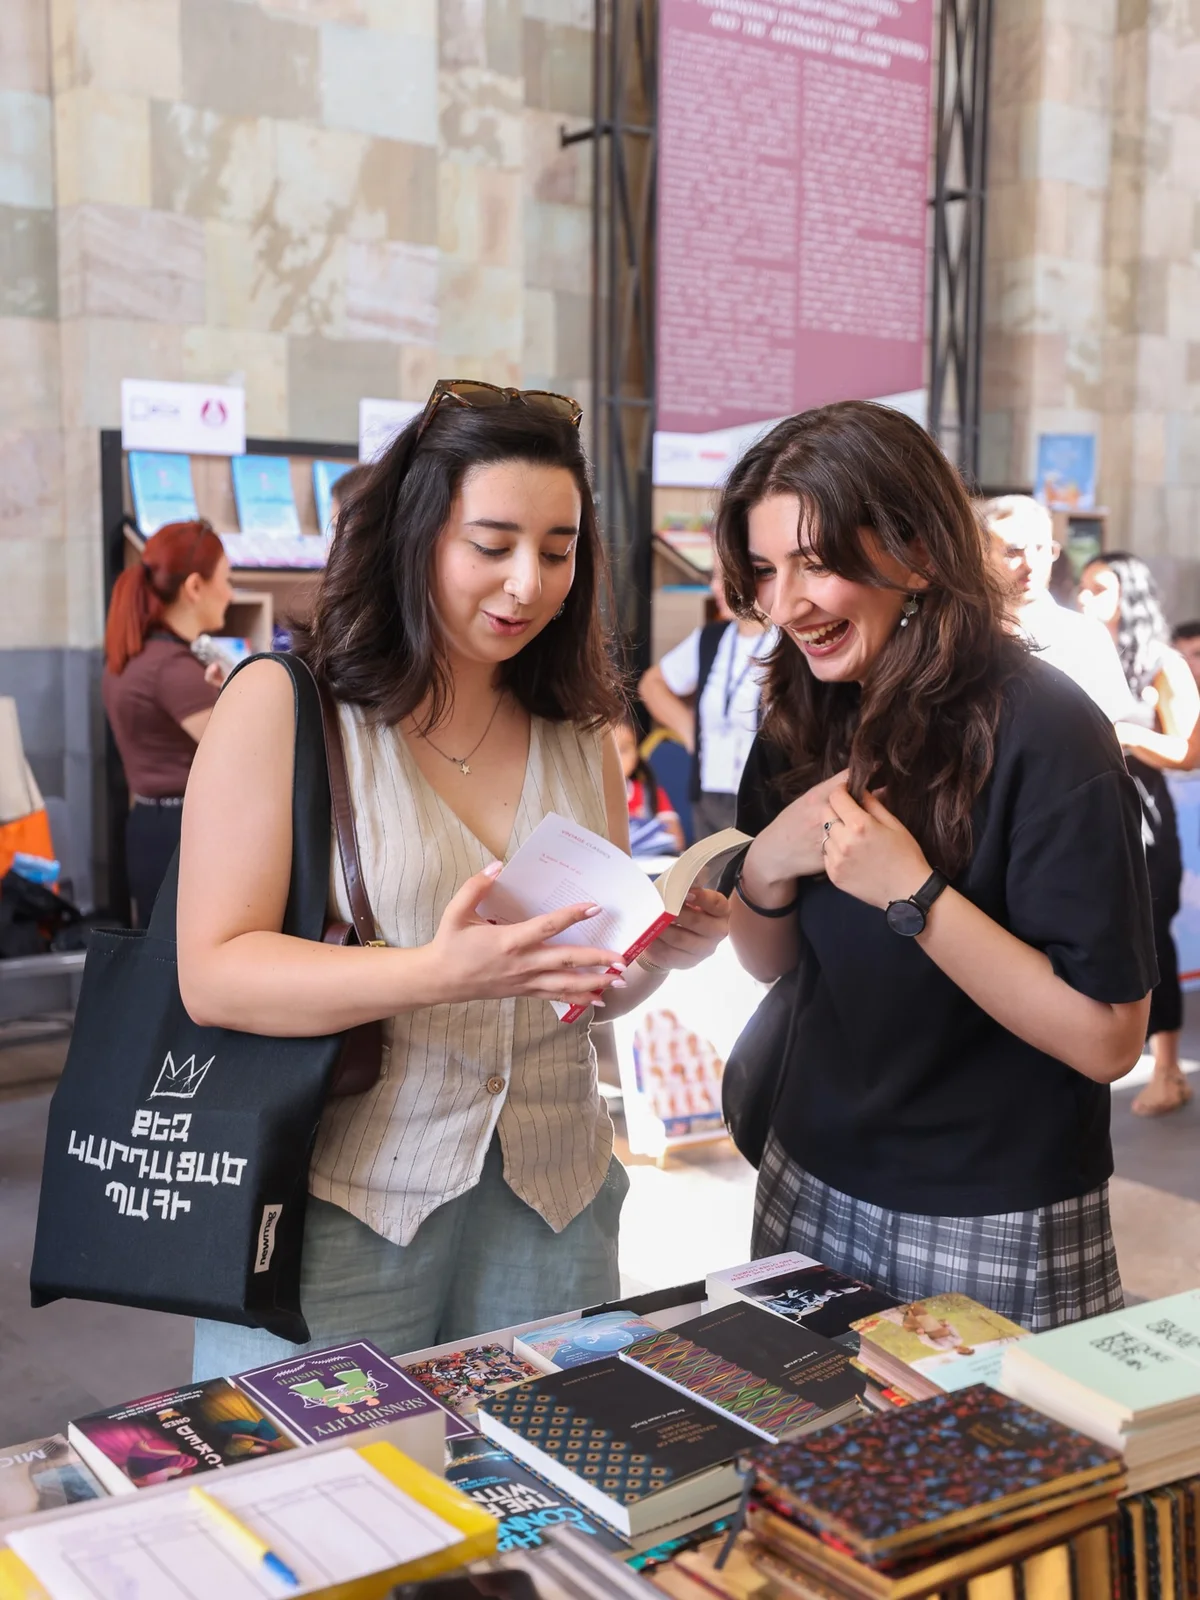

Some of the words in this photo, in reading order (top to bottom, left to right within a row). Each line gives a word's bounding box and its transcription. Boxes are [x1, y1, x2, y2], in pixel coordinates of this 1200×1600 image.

[259, 1210, 277, 1266] newmag
[329, 1360, 360, 1372] Jane
[276, 1368, 325, 1386] Austen
[162, 1416, 190, 1428] ONES
[312, 1397, 428, 1437] SENSIBILITY
[500, 1493, 560, 1514] THE
